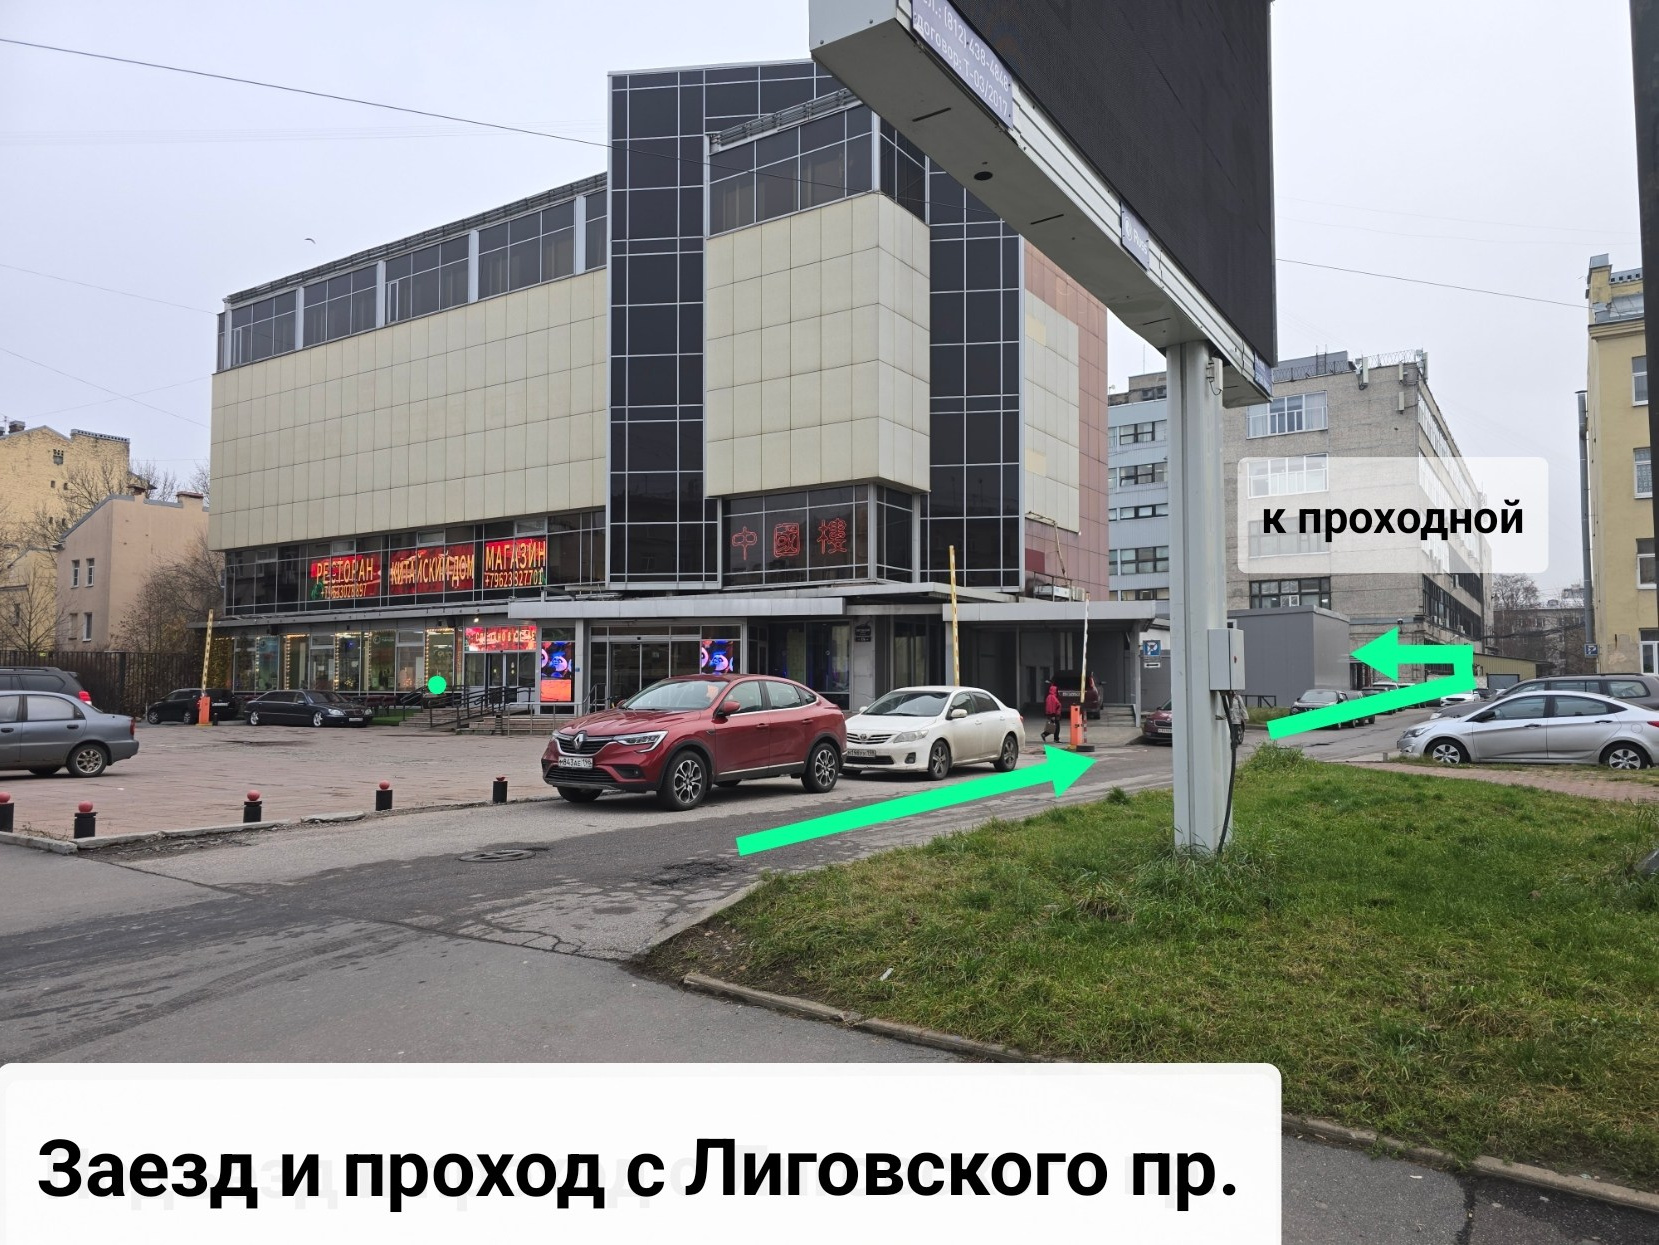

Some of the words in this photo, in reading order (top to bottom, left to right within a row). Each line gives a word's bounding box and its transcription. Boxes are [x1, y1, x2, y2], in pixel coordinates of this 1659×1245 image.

[944, 6, 967, 49] (812)
[969, 39, 1009, 92] 438-4848
[316, 557, 374, 585] РЕСТОРАН
[390, 549, 449, 585] КИТАЙСКИЙ
[451, 554, 475, 588] ДОМ
[486, 540, 546, 571] МАГАЗИН
